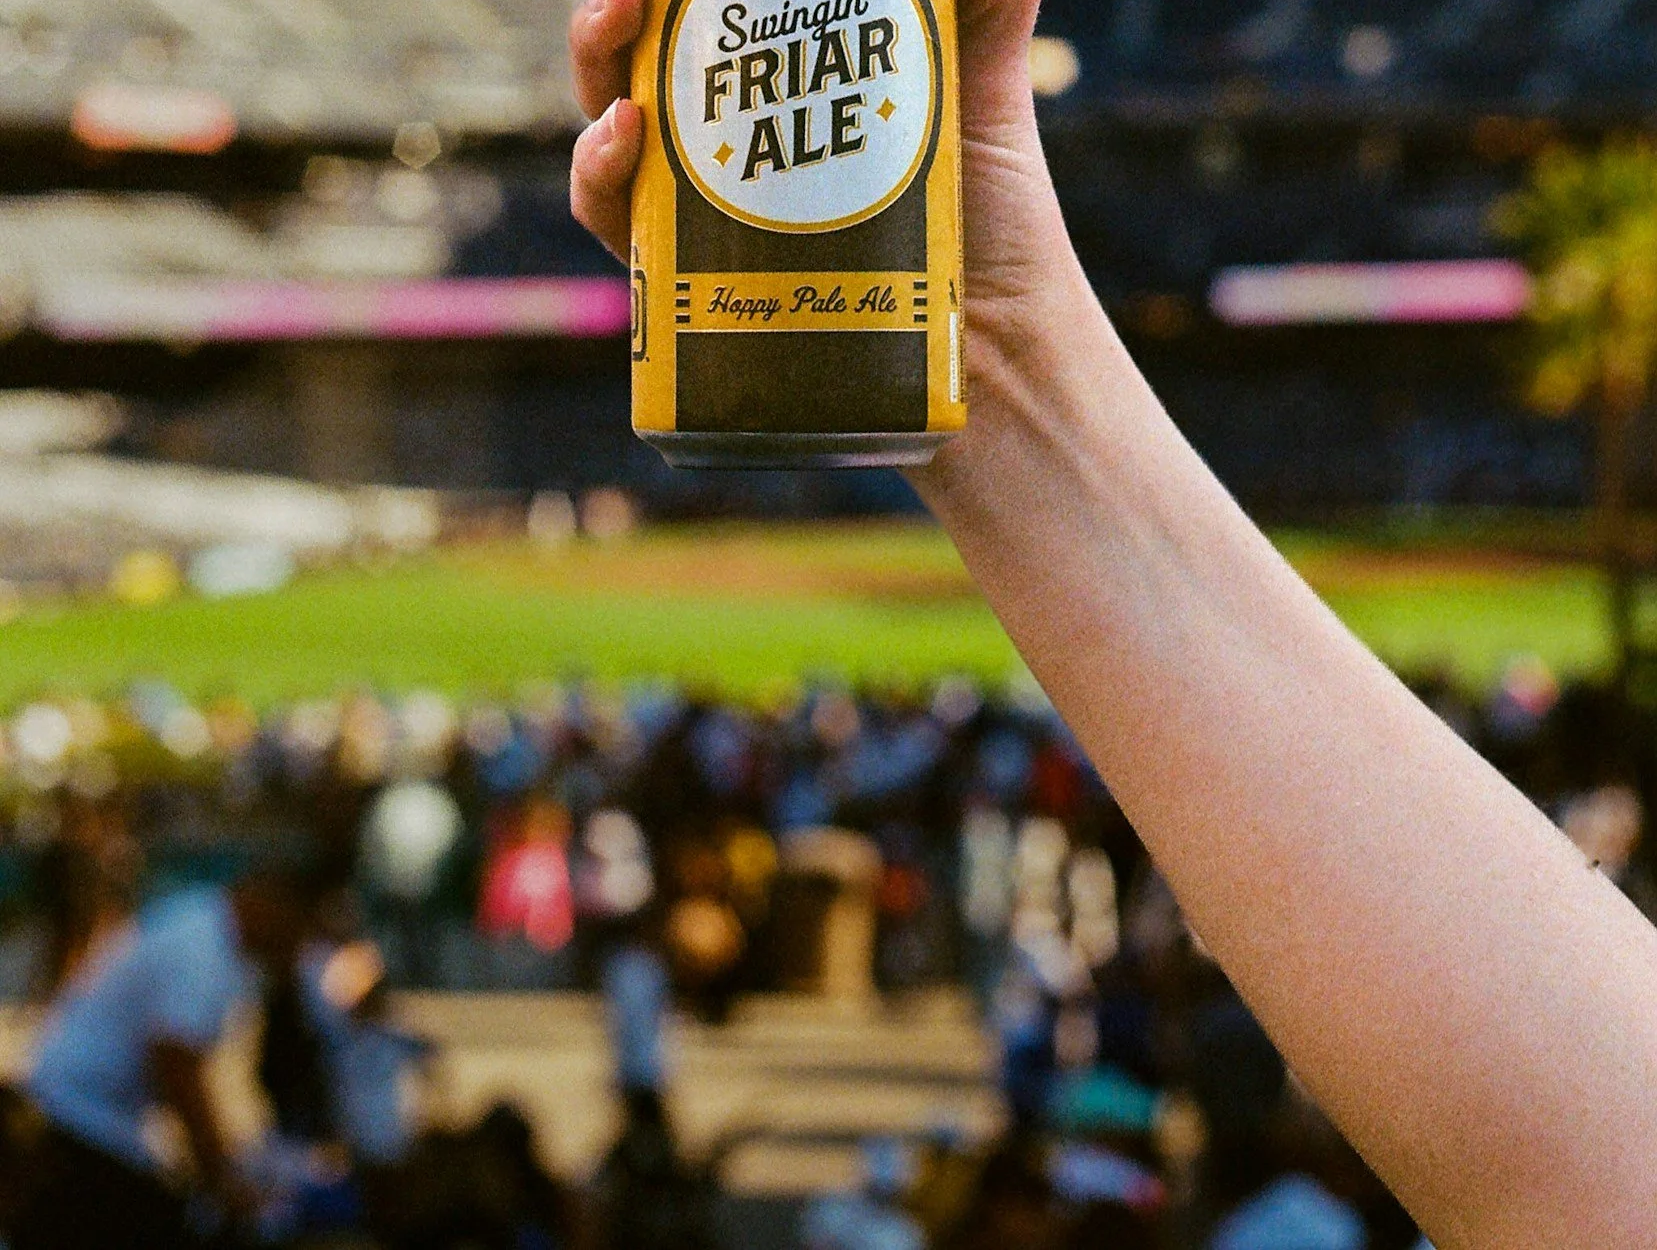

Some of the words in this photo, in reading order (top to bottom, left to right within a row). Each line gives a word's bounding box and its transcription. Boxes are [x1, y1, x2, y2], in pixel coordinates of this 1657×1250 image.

[703, 16, 899, 125] FRIAR
[740, 93, 868, 182] ALE
[706, 286, 781, 320] Hoppy
[788, 285, 847, 314] Pale
[854, 285, 898, 314] Ale
